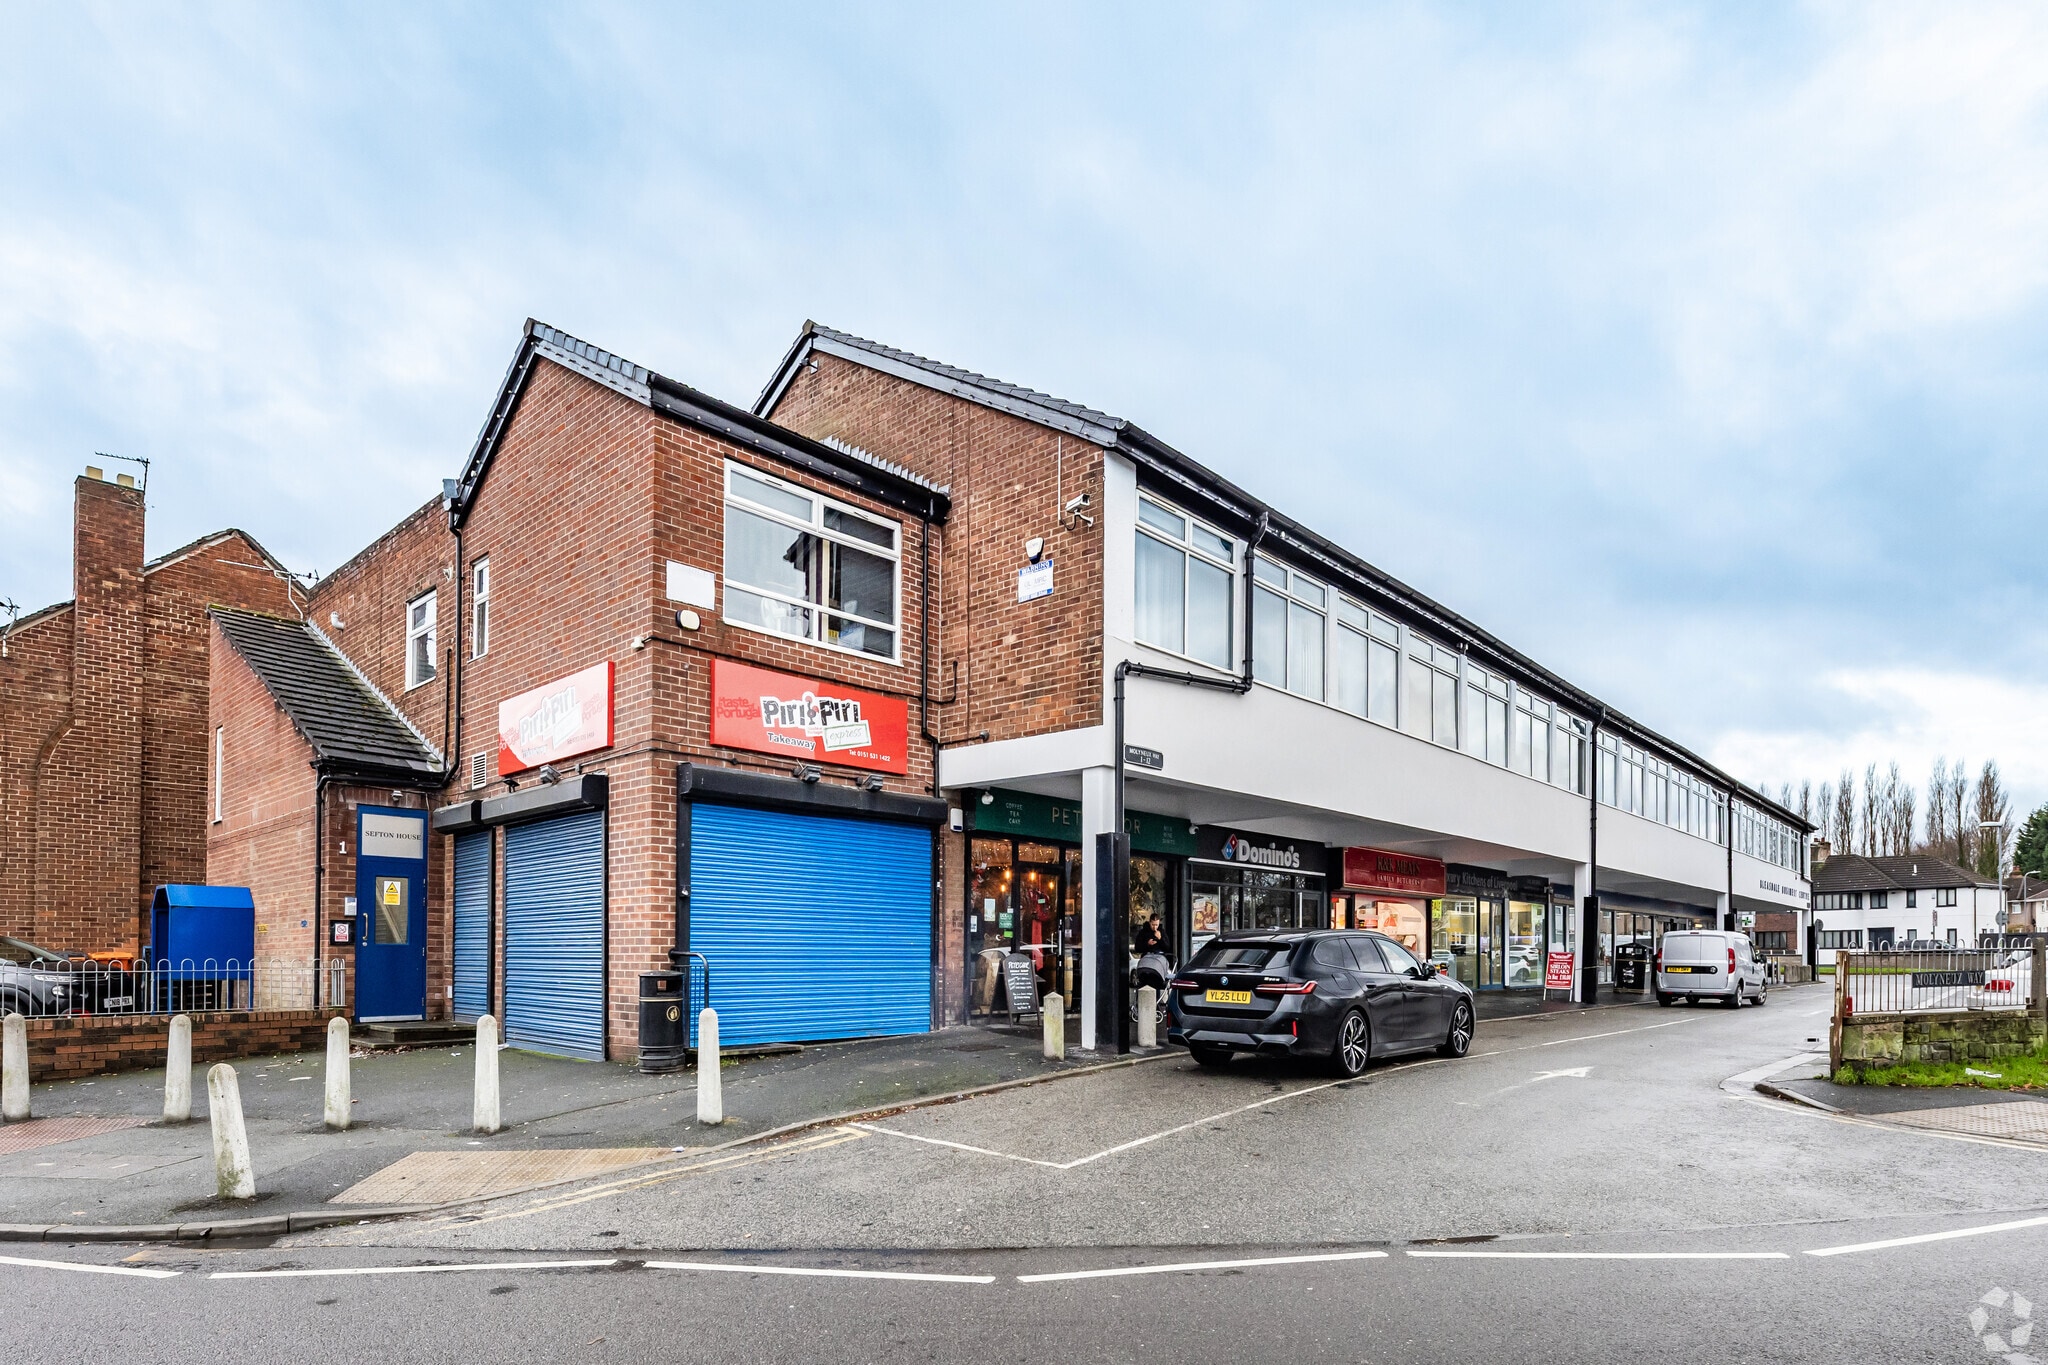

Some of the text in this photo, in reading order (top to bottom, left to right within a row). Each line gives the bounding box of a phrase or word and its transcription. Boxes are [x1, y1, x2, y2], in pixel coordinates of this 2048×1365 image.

[716, 706, 761, 720] Portugal
[762, 698, 859, 726] Piri Piri
[767, 732, 815, 750] Takeaway
[830, 728, 862, 745] express
[857, 750, 869, 758] 0151
[879, 754, 891, 762] 1422
[1052, 806, 1082, 826] PET
[365, 830, 422, 841] SEFTON HOUSE
[339, 841, 347, 854] 1
[1236, 839, 1300, 868] Domino's
[1462, 872, 1486, 887] Kitchens
[1487, 876, 1494, 887] of
[1494, 877, 1518, 891] Liverpool
[1967, 971, 1984, 984] WAY
[1210, 991, 1248, 1002] YL25 LLU
